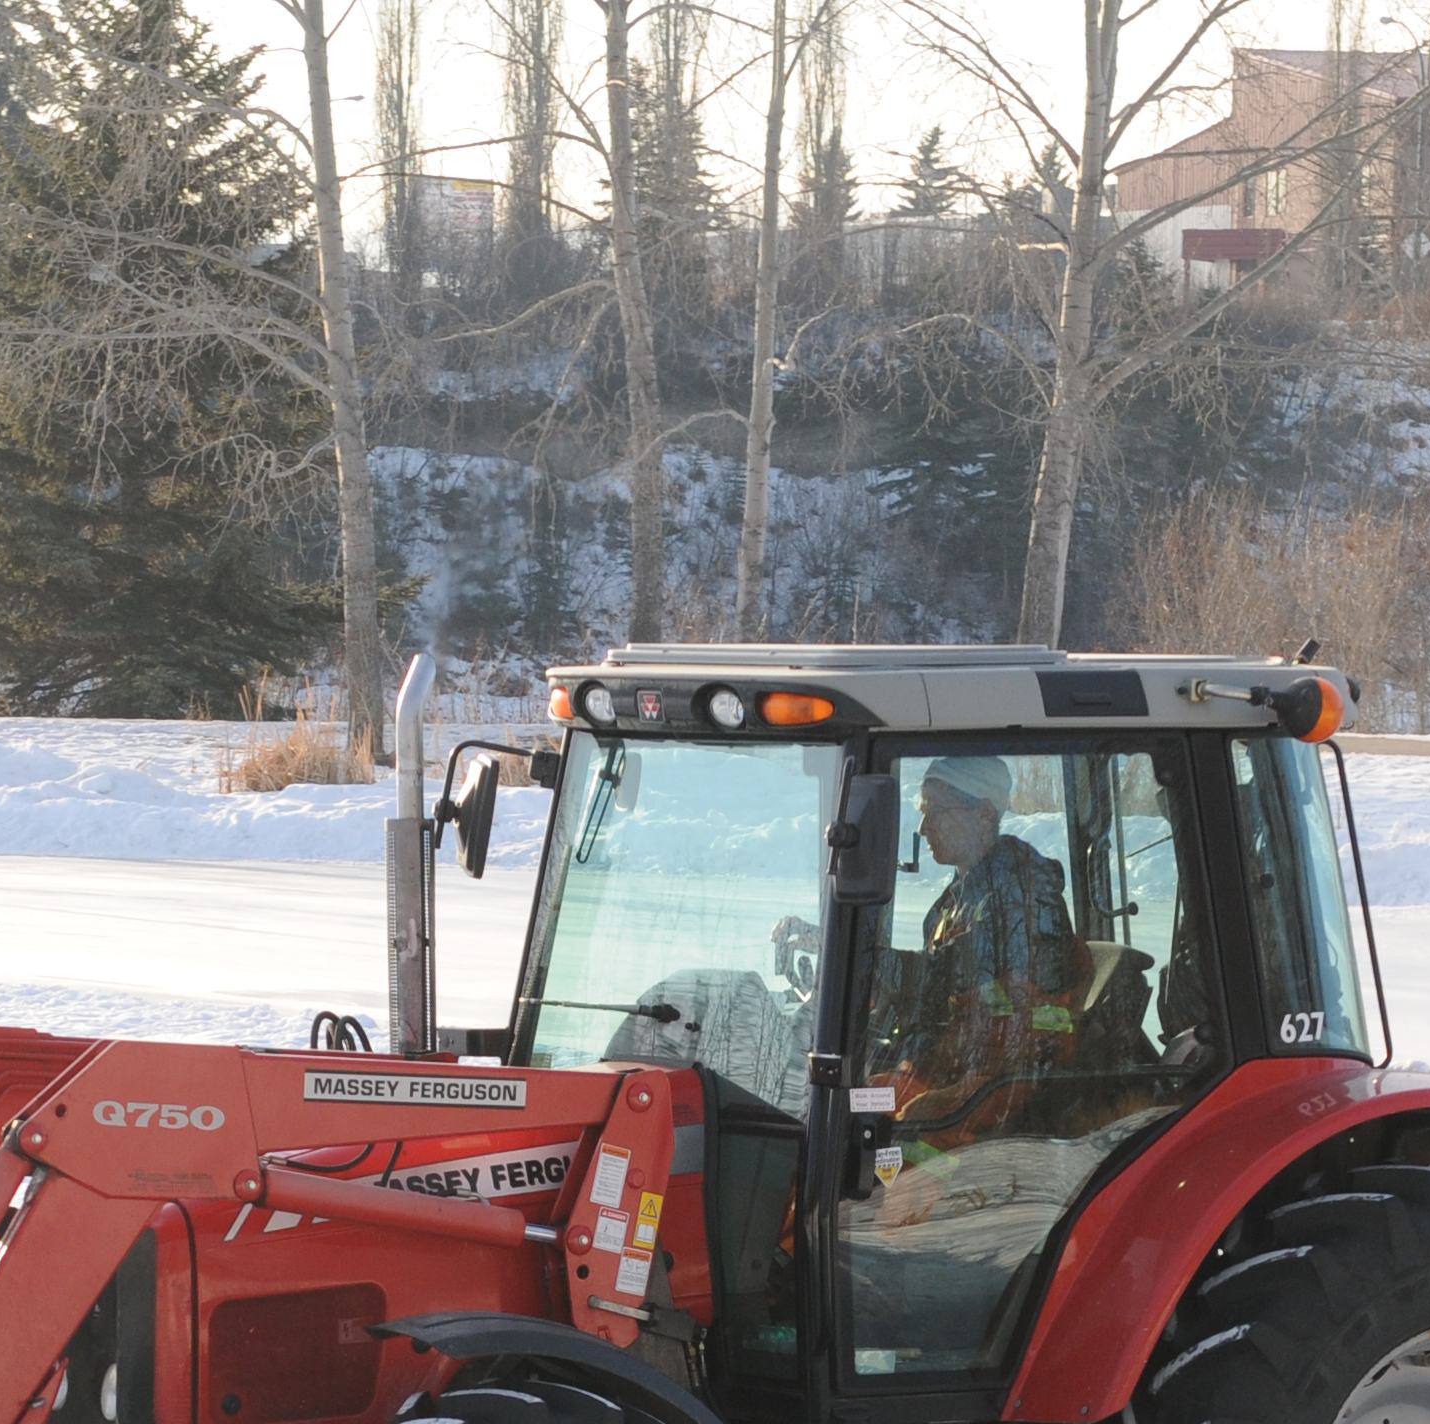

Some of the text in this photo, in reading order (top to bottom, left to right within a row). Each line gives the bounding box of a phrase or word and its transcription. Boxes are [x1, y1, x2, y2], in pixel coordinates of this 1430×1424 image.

[1280, 1011, 1324, 1043] 627
[313, 1077, 517, 1101] MASSEY FERGUSON
[92, 1100, 226, 1131] Q750
[490, 1155, 571, 1190] FERG
